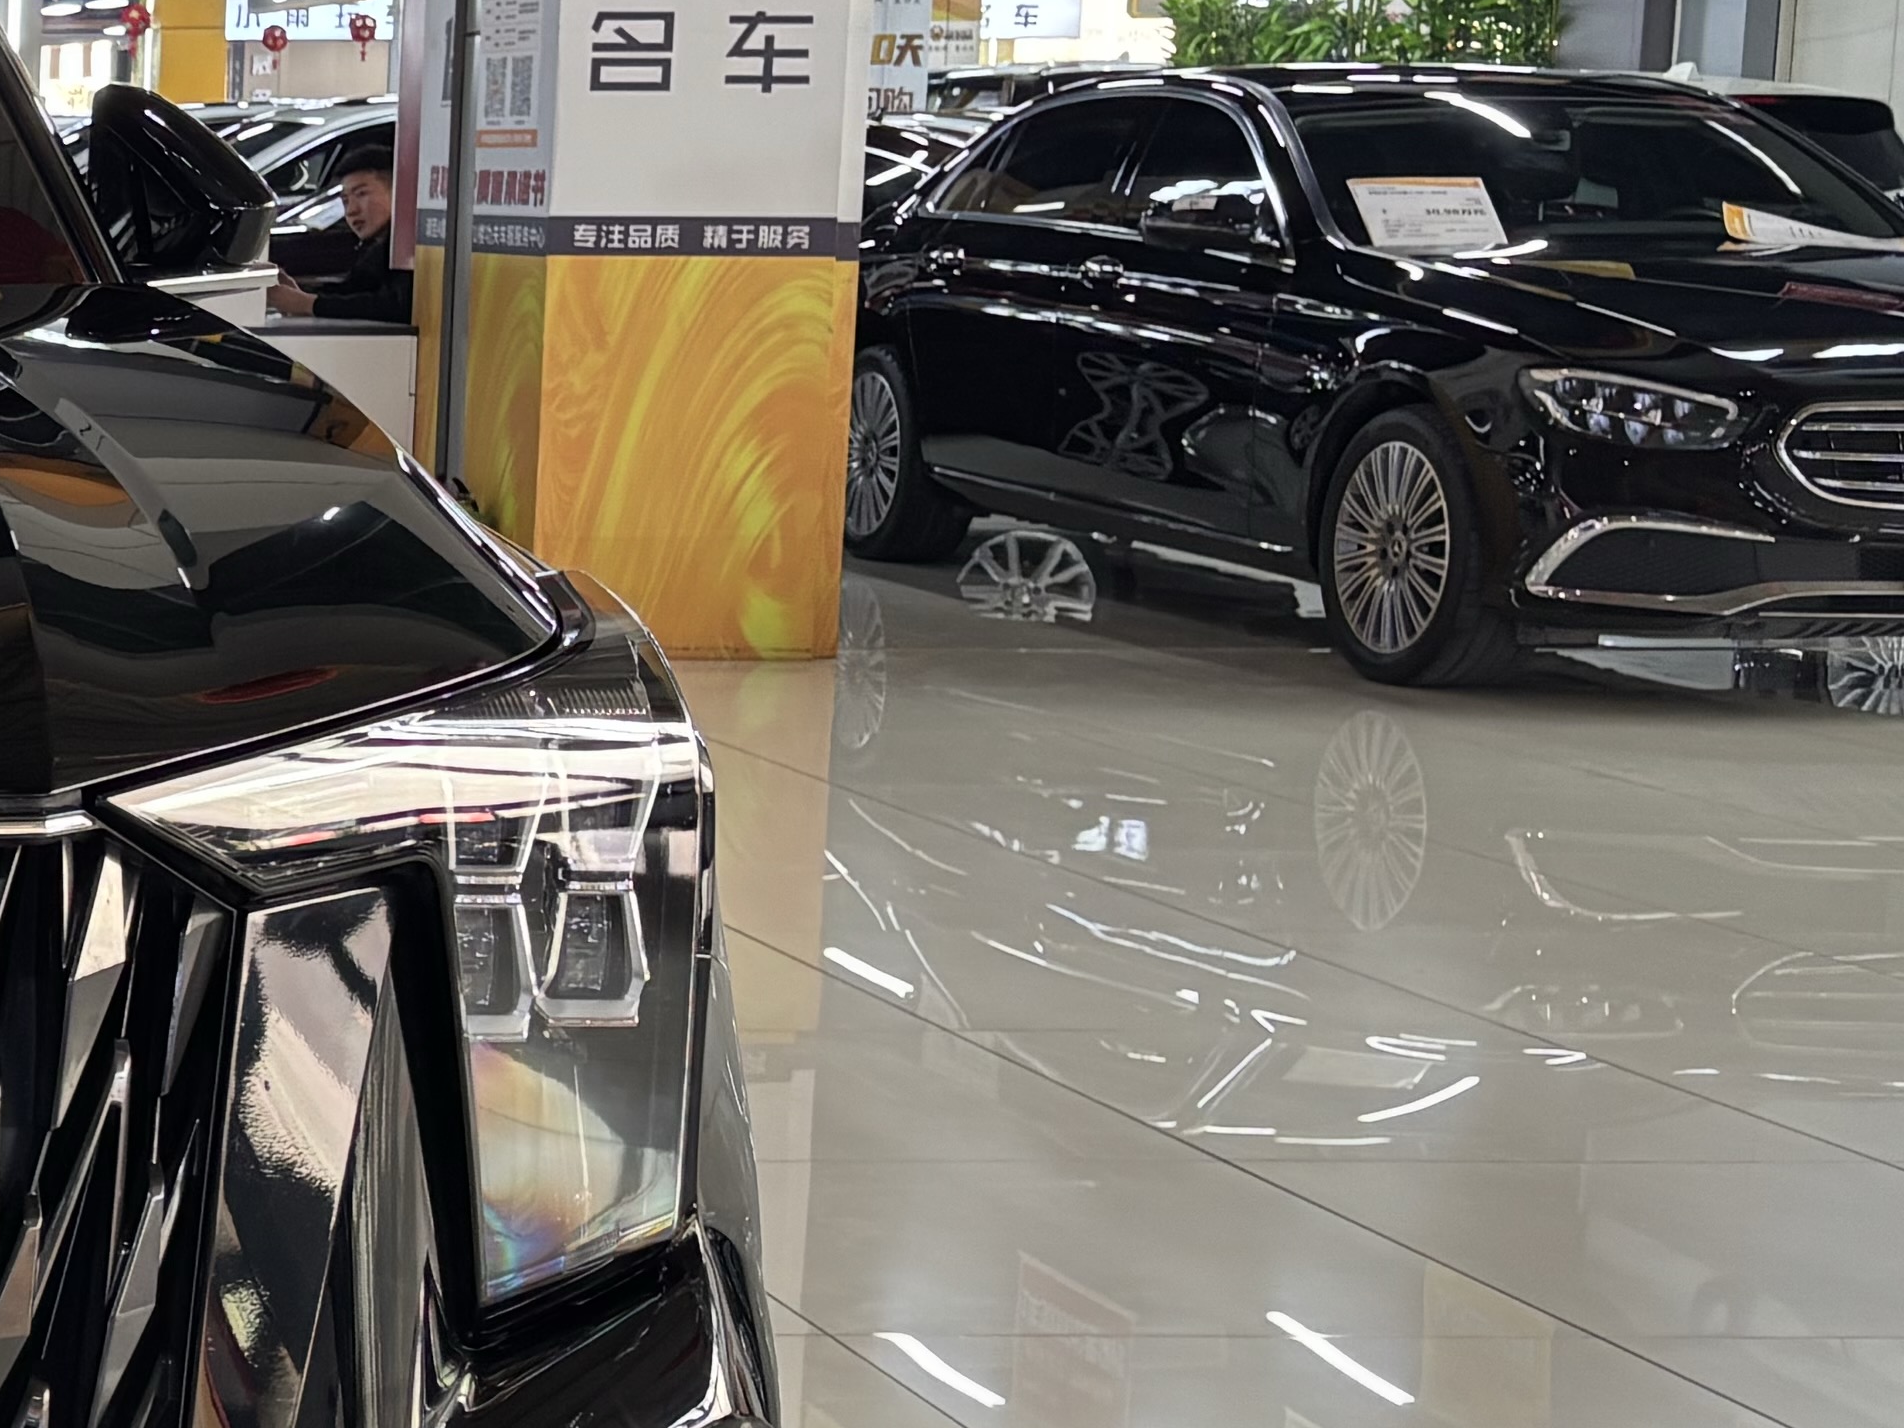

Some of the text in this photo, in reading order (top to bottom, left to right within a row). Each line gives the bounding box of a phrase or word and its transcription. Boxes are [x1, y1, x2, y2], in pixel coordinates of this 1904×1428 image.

[589, 10, 814, 94] 名车
[573, 223, 681, 250] 专注品质
[703, 223, 811, 251] 精于服务
